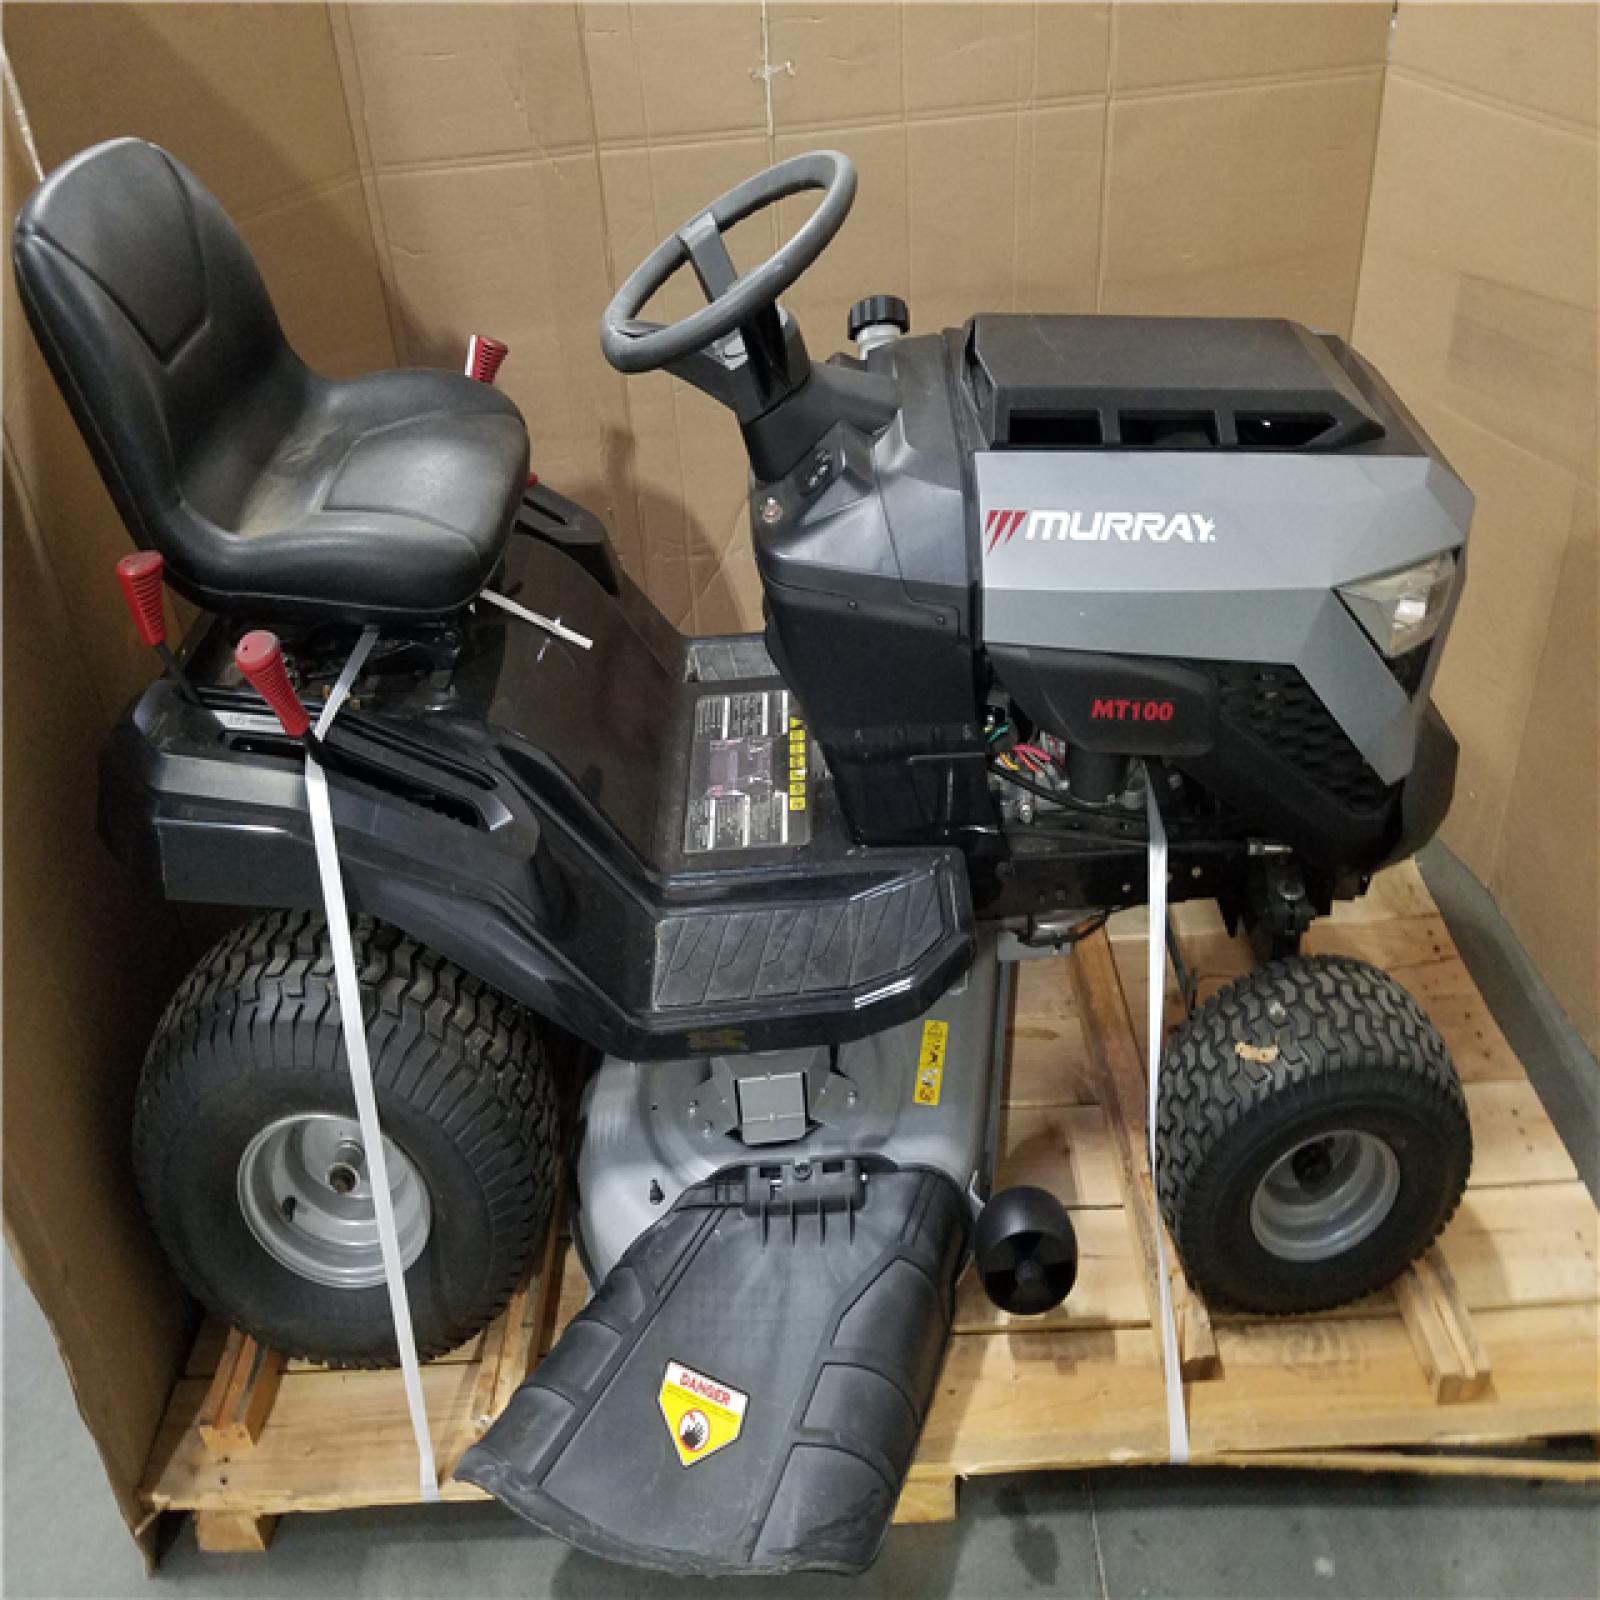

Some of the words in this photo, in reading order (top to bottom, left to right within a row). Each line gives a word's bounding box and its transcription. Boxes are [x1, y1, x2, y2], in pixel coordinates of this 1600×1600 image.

[1025, 509, 1216, 543] MURRAY
[1090, 697, 1175, 722] MT100
[679, 1370, 731, 1406] DANGER
